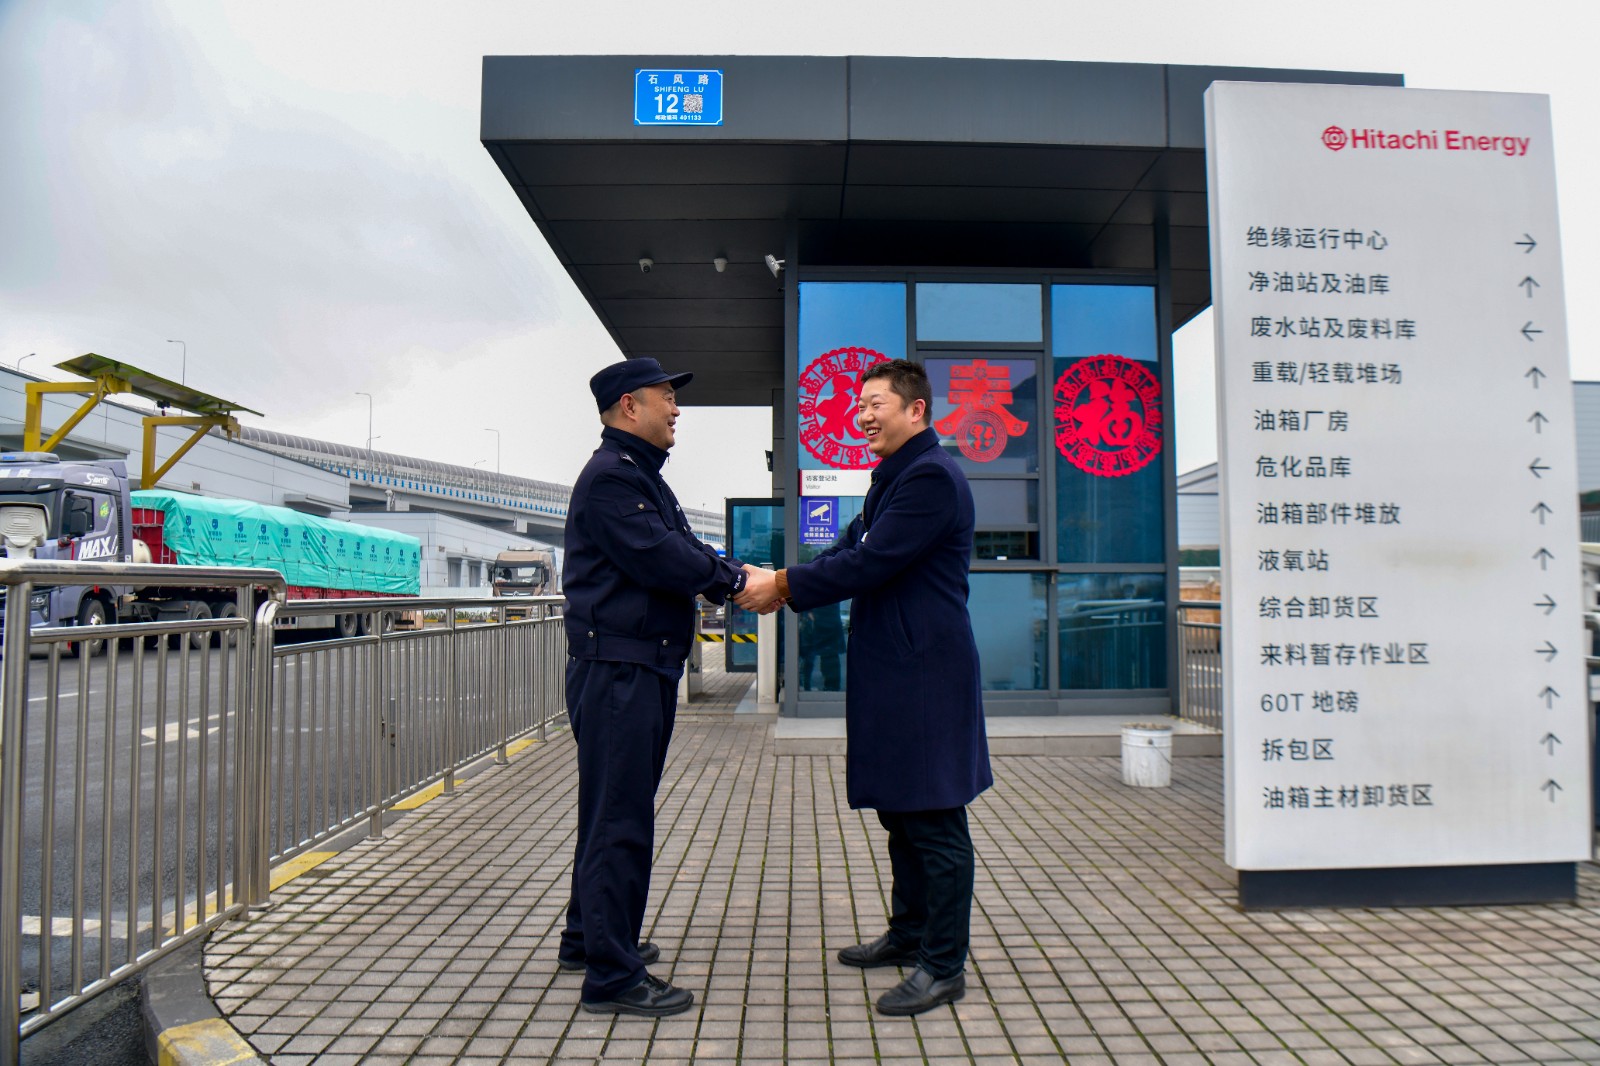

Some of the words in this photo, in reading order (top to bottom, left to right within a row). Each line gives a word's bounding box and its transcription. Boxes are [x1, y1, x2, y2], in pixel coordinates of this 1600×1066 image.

[648, 74, 709, 85] 石风路
[654, 93, 679, 113] 12
[1351, 128, 1438, 150] Hitachi
[1445, 130, 1530, 156] Energy
[1247, 226, 1388, 250] 绝缘运行中心
[1248, 271, 1389, 294] 净油站及油库
[1251, 316, 1416, 339] 废水站及废料库
[1252, 361, 1401, 385] 重载/轻载堆场
[1254, 409, 1348, 431] 油箱厂房
[1256, 455, 1351, 478] 危化品库
[1257, 502, 1400, 524] 油箱部件堆放
[1258, 549, 1328, 571] 液氧站
[1259, 596, 1379, 618] 综合卸货区
[1261, 643, 1429, 666] 来料暂存作业区
[1261, 693, 1304, 712] 60T
[1312, 690, 1358, 713] 地磅
[1262, 738, 1334, 761] 拆包区
[1263, 784, 1433, 808] 油箱主材卸货区
